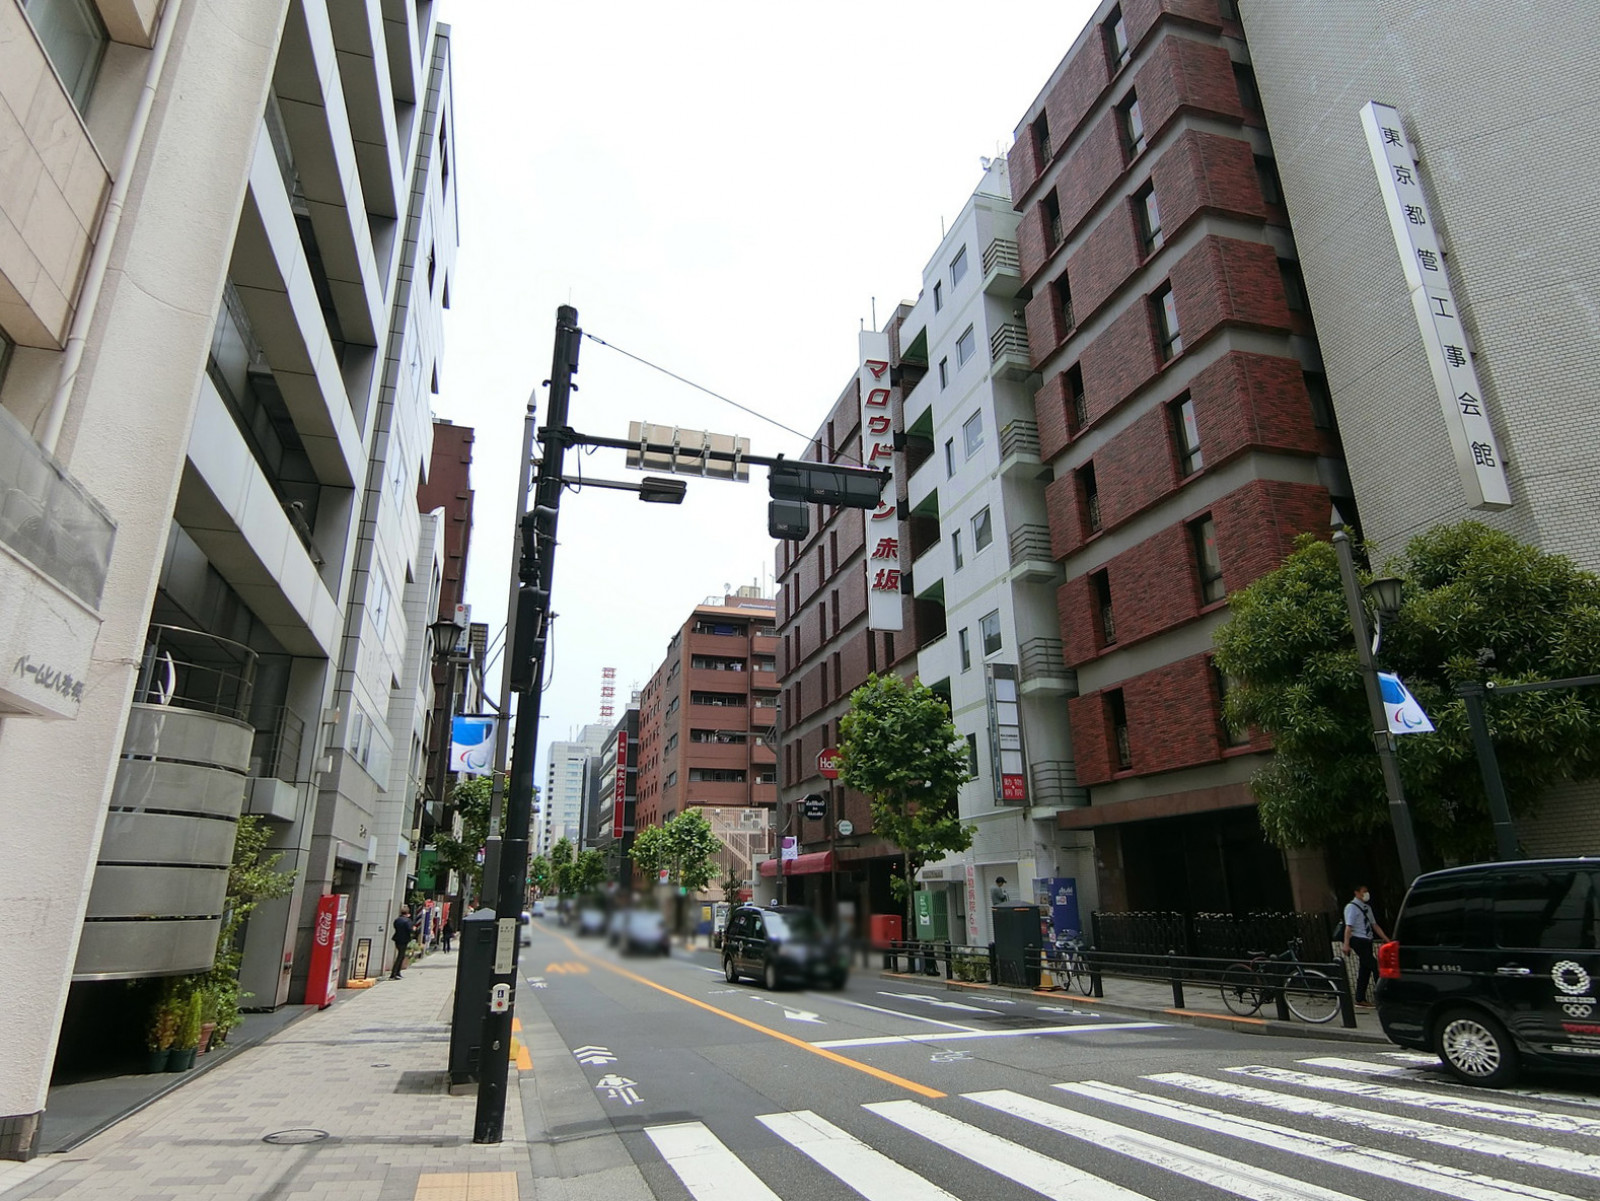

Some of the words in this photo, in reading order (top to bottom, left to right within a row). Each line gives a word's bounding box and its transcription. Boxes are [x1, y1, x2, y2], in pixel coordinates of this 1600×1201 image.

[1381, 126, 1496, 469] 東京都管工事会館
[864, 359, 901, 592] マロウドン赤坂
